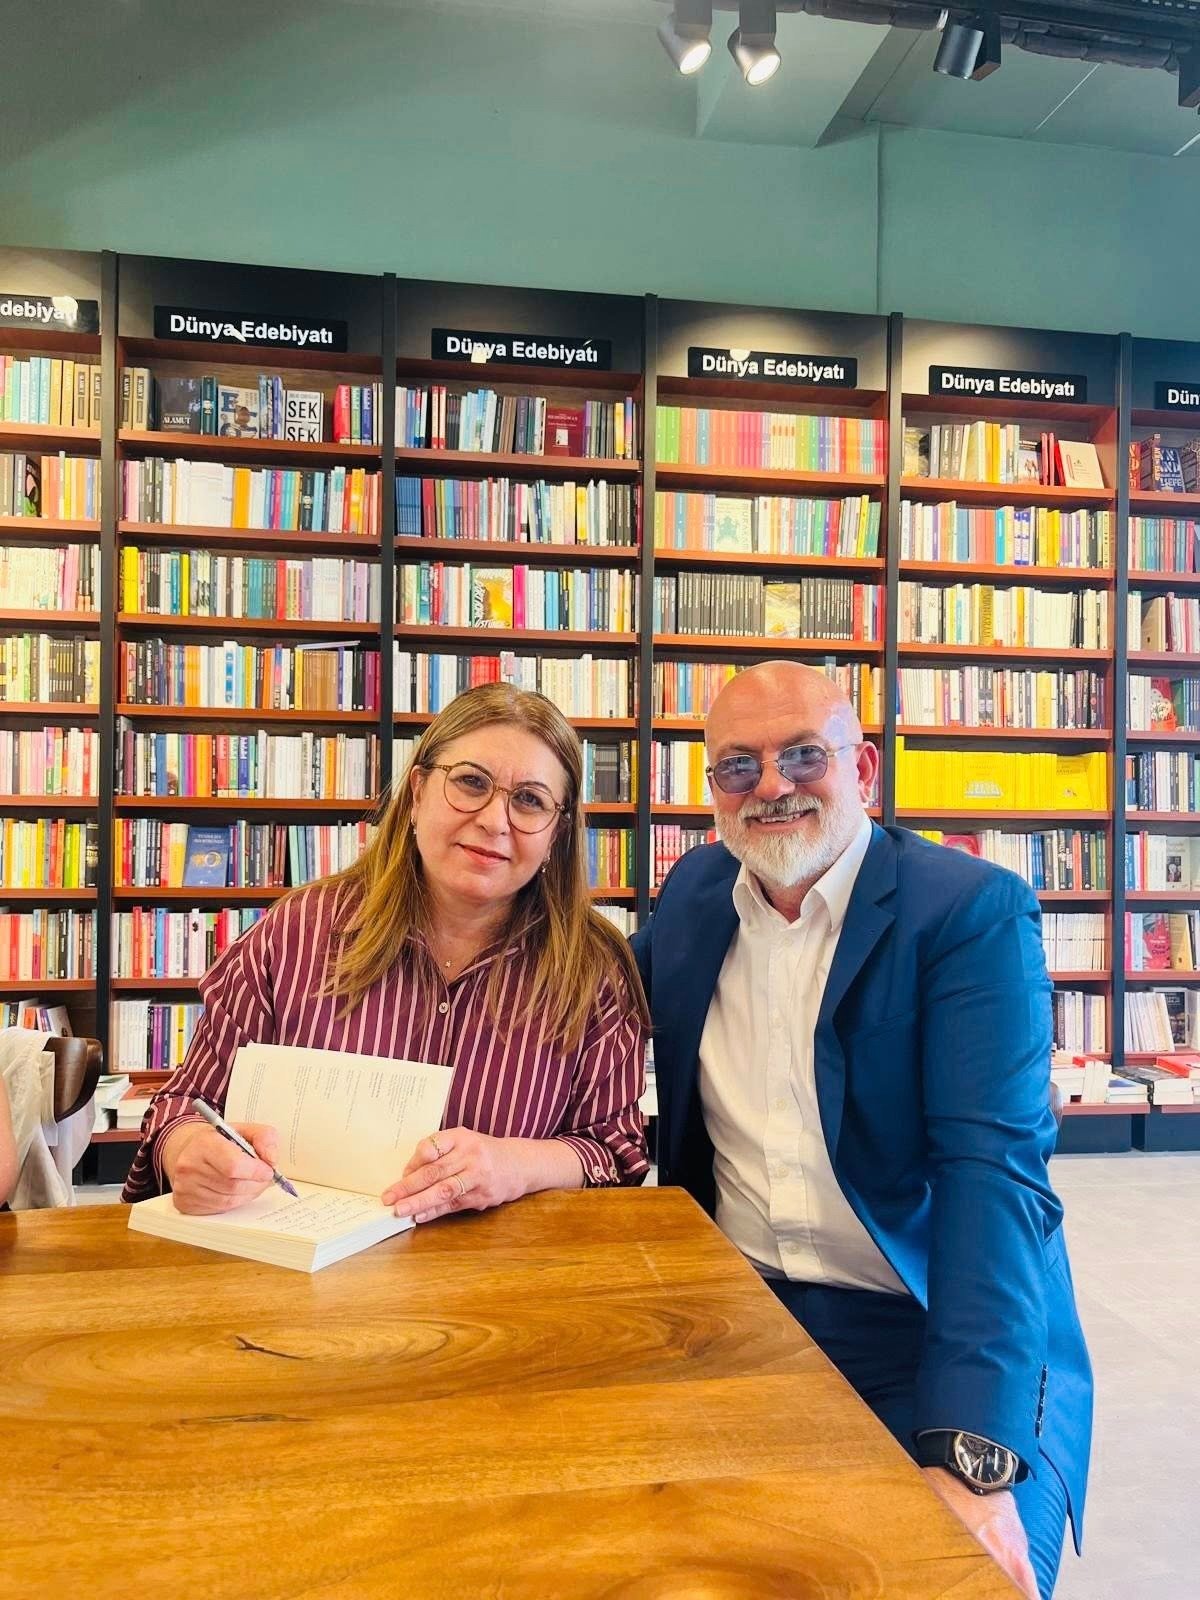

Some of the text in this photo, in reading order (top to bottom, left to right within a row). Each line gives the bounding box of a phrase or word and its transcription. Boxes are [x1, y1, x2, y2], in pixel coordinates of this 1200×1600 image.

[0, 300, 77, 323] debiya
[170, 314, 333, 345] Dünya Edebiyatı
[512, 340, 598, 365] Edebiyatı
[702, 354, 844, 381] Dünya Edebiyatı
[941, 372, 1075, 398] Dünya Edebiyatı
[1167, 388, 1200, 405] Dün
[287, 400, 318, 419] SEK
[287, 426, 317, 443] SEK
